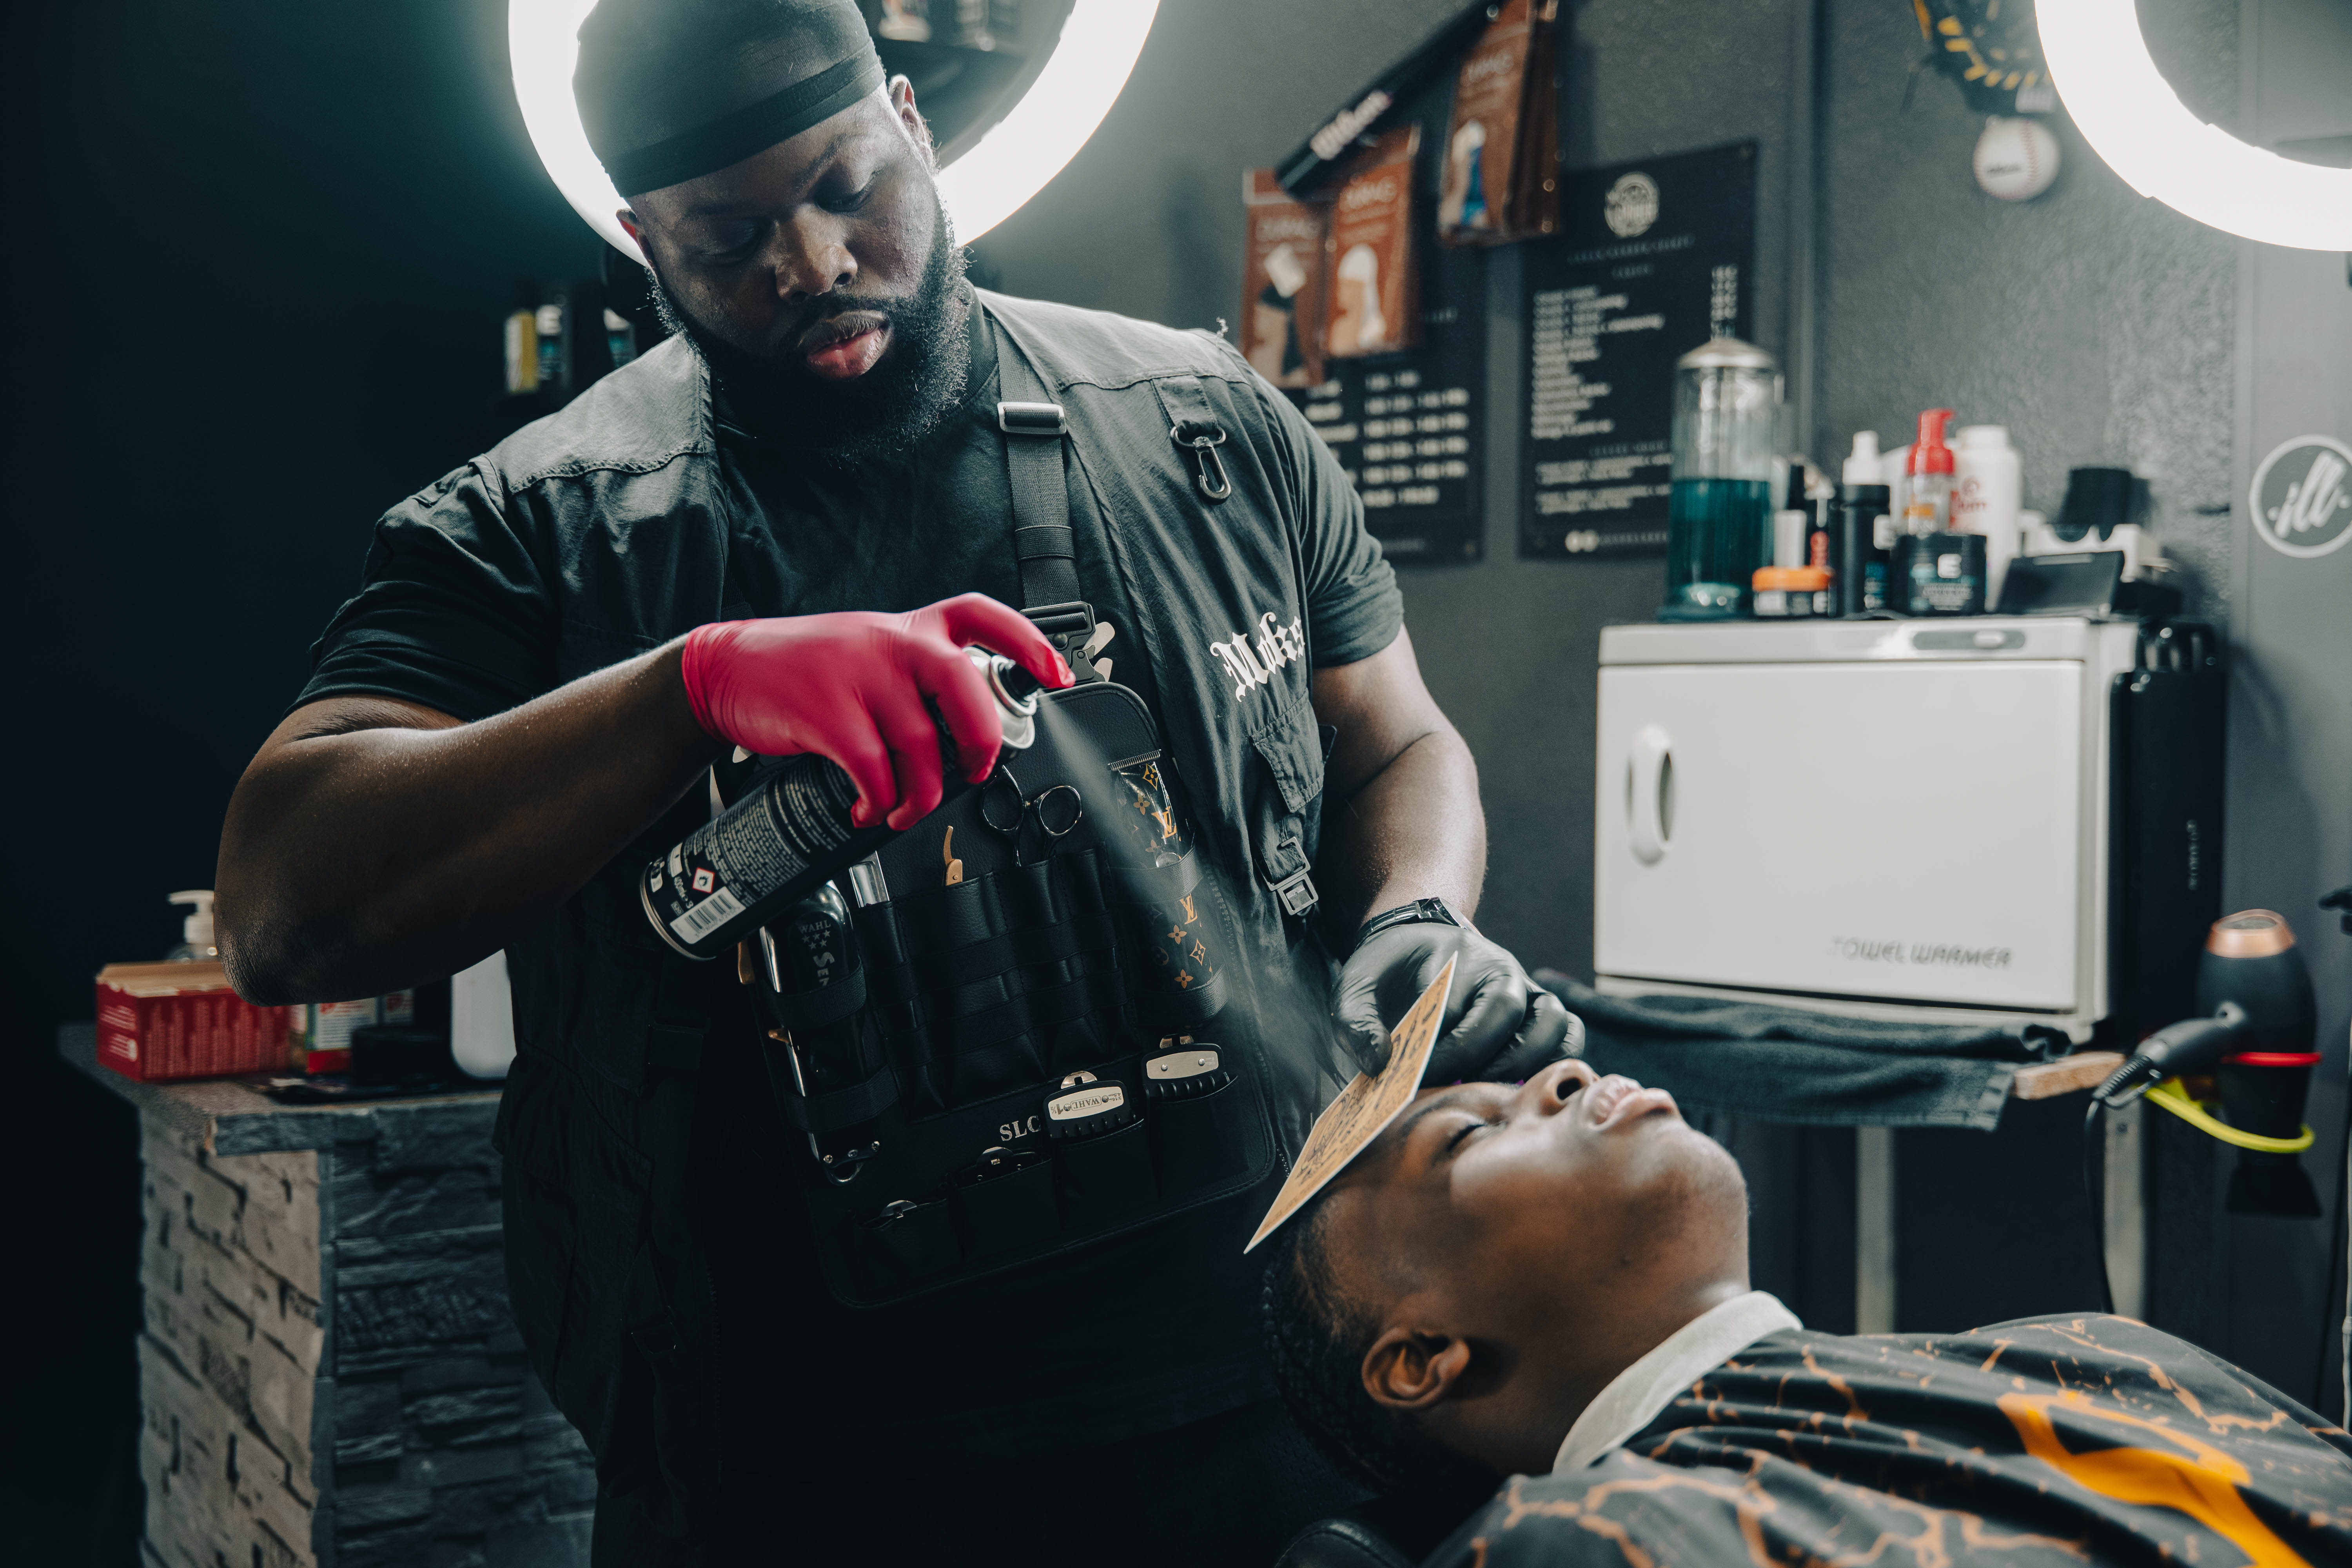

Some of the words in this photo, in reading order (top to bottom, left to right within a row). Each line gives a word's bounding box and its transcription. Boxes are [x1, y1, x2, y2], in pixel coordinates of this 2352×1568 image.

[798, 920, 831, 934] WAHL
[1831, 935, 1905, 964] TOWEL
[1910, 943, 2013, 969] WARMER
[1072, 1098, 1100, 1109] WAHL
